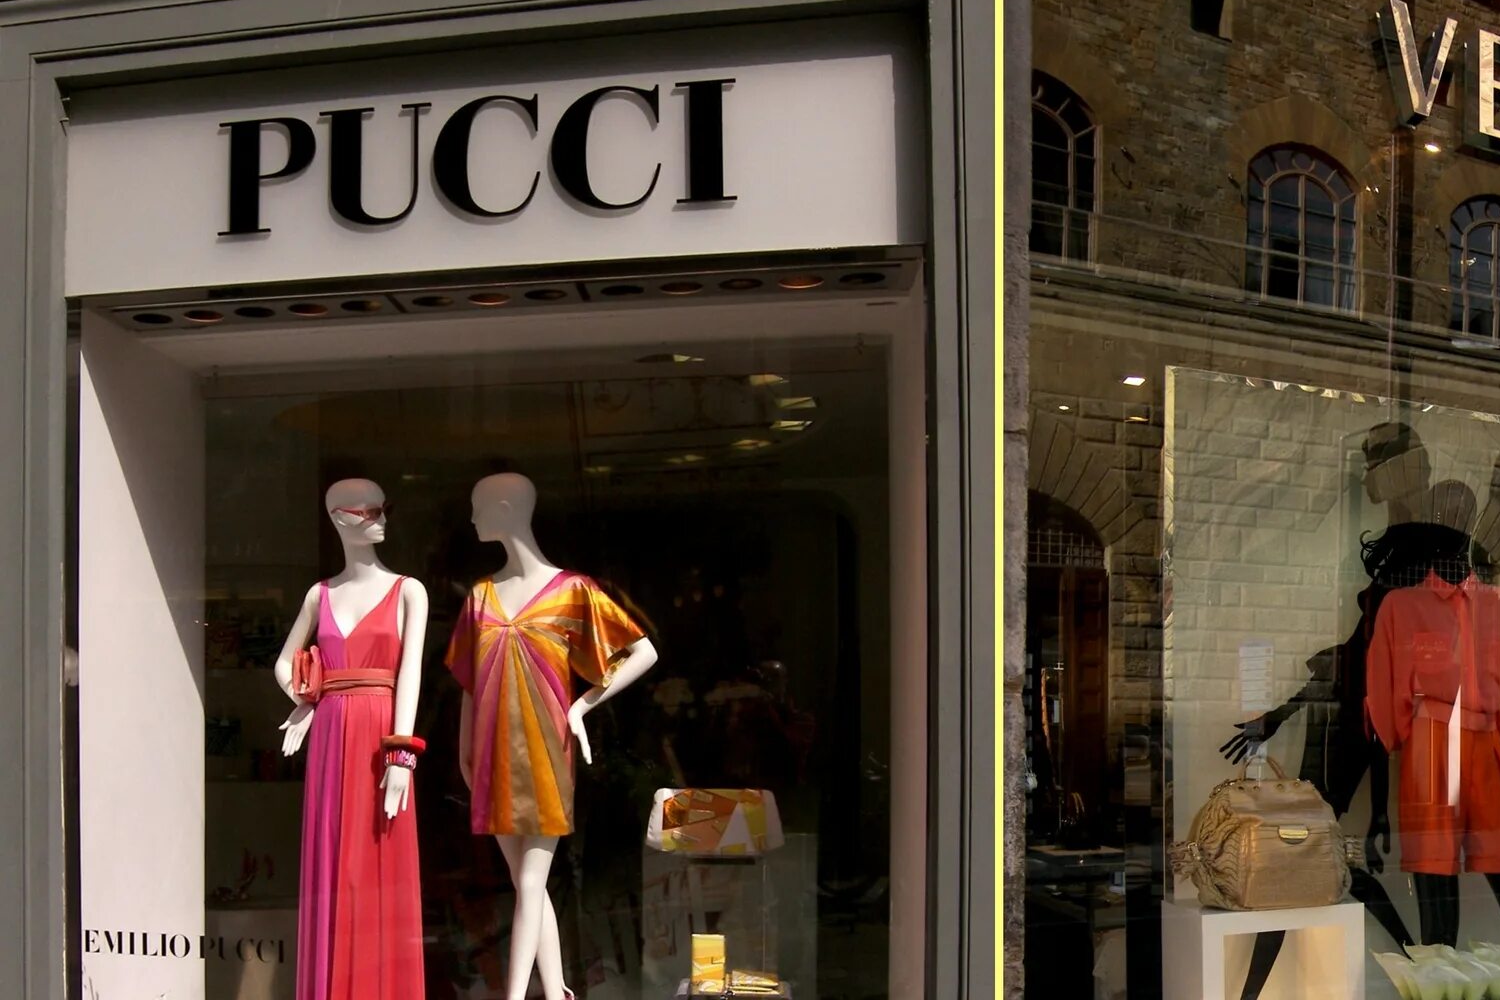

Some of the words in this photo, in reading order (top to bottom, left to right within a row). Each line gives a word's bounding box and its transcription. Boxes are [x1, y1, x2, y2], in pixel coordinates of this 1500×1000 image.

[217, 78, 738, 236] PUCCI
[84, 929, 191, 959] EMILIO
[199, 935, 285, 964] PUCCI
